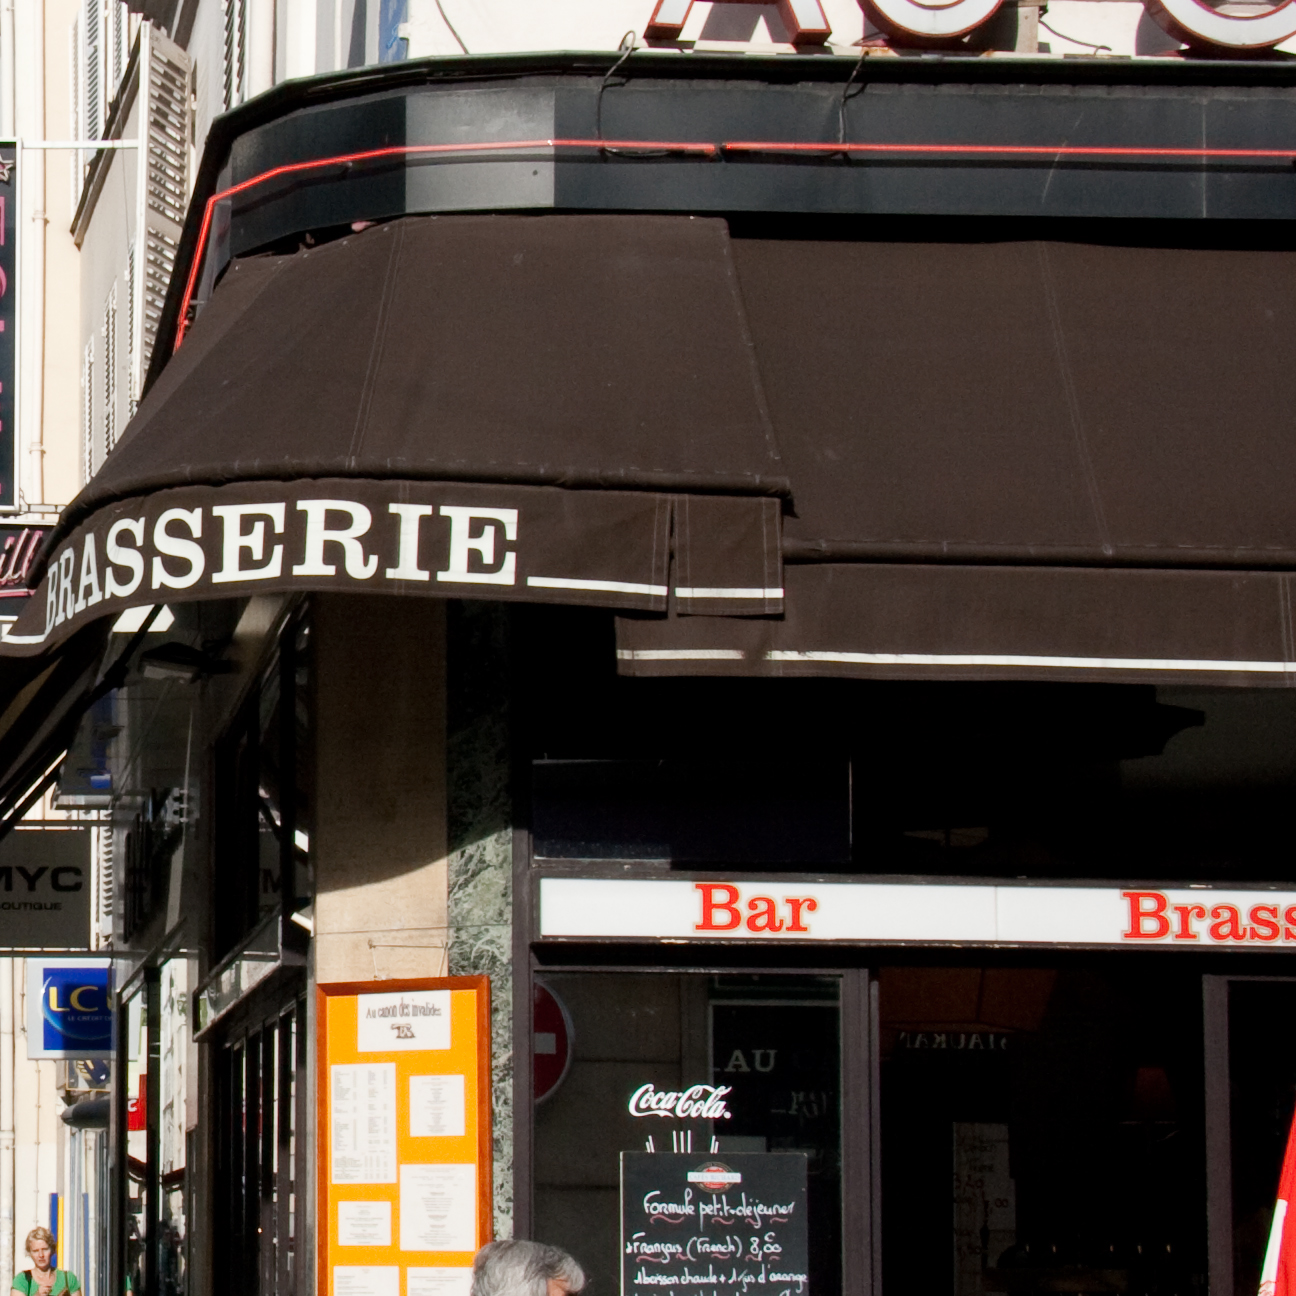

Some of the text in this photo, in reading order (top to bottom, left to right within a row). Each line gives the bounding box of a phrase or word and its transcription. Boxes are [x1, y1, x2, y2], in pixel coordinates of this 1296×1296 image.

[47, 500, 518, 629] BRASSERIE
[695, 882, 817, 933] Bar
[366, 1007, 376, 1019] Au
[399, 997, 410, 1018] des
